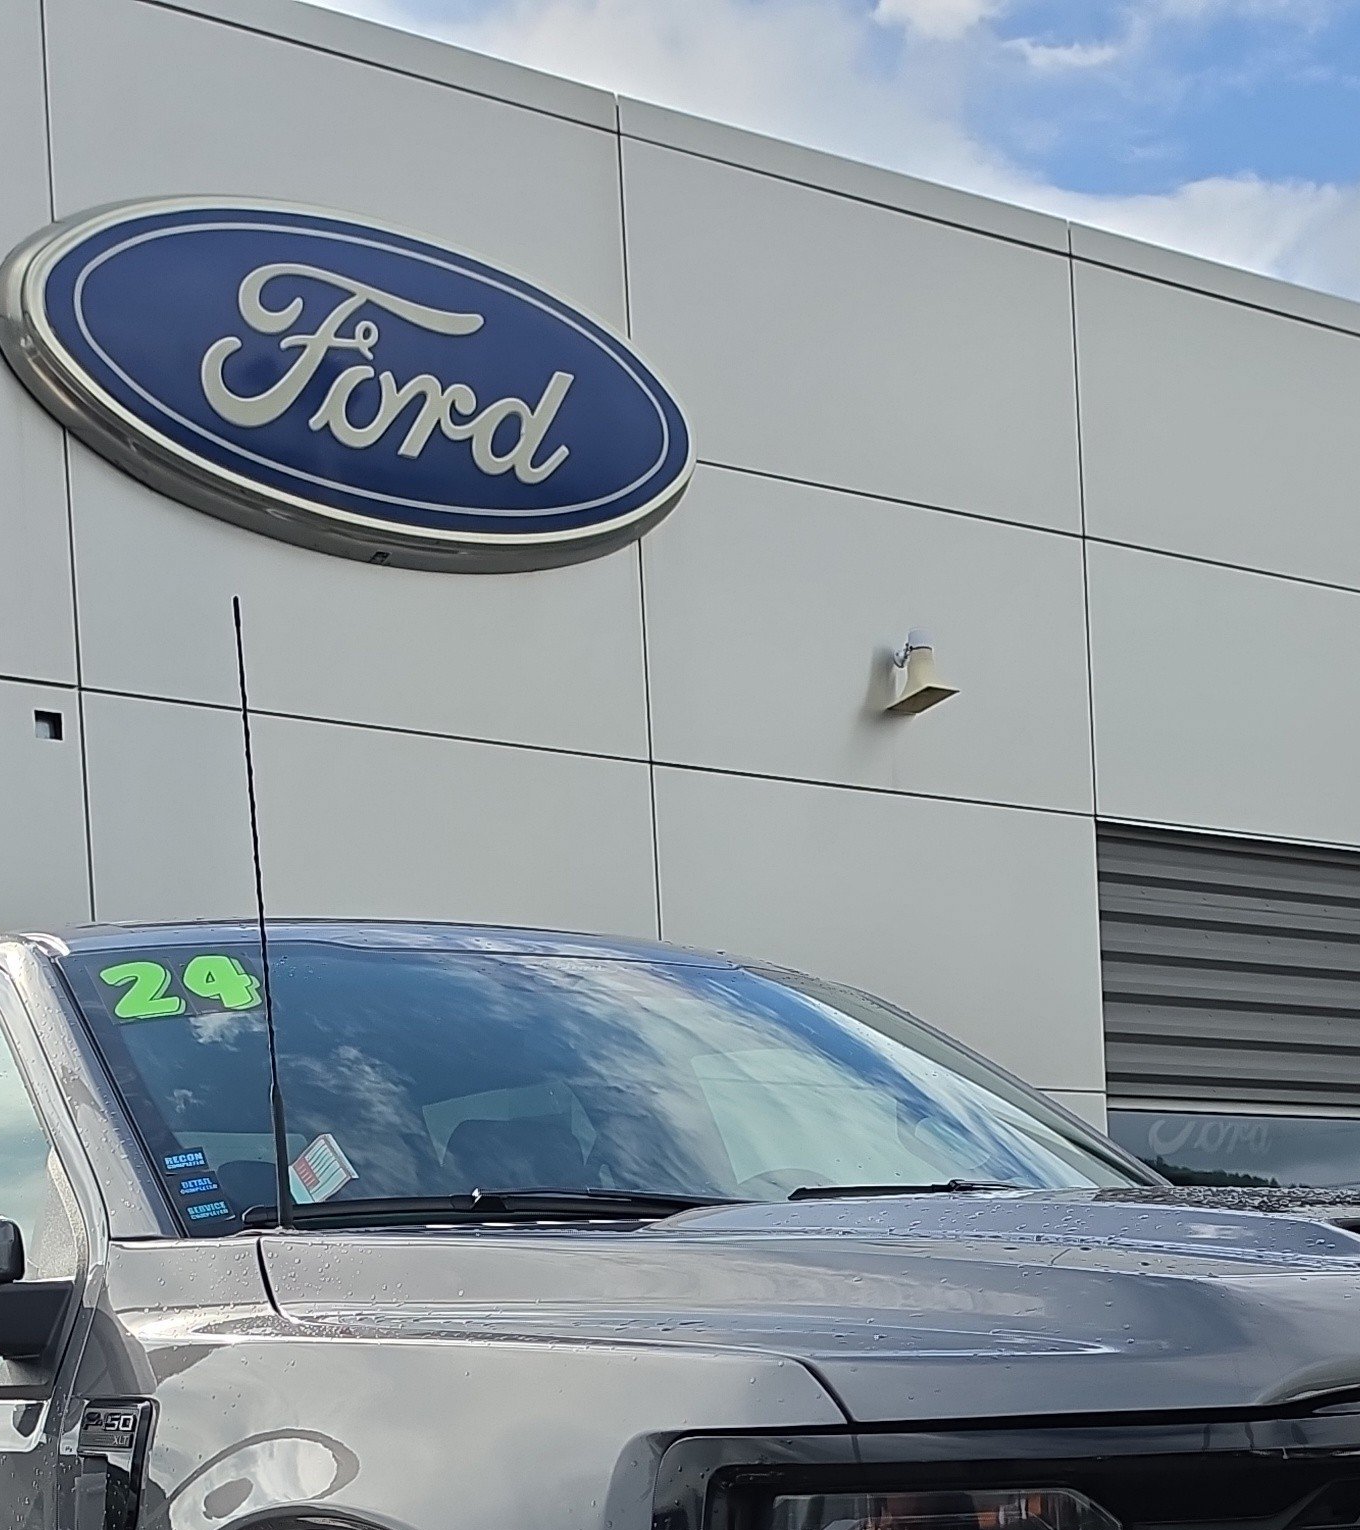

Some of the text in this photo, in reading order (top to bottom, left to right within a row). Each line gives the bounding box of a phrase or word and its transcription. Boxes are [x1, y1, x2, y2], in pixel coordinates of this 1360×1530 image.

[201, 262, 574, 485] Ford
[100, 955, 263, 1019] 24
[164, 1152, 204, 1165] RECON
[181, 1177, 213, 1189] DETAIL
[112, 1435, 130, 1445] XLT
